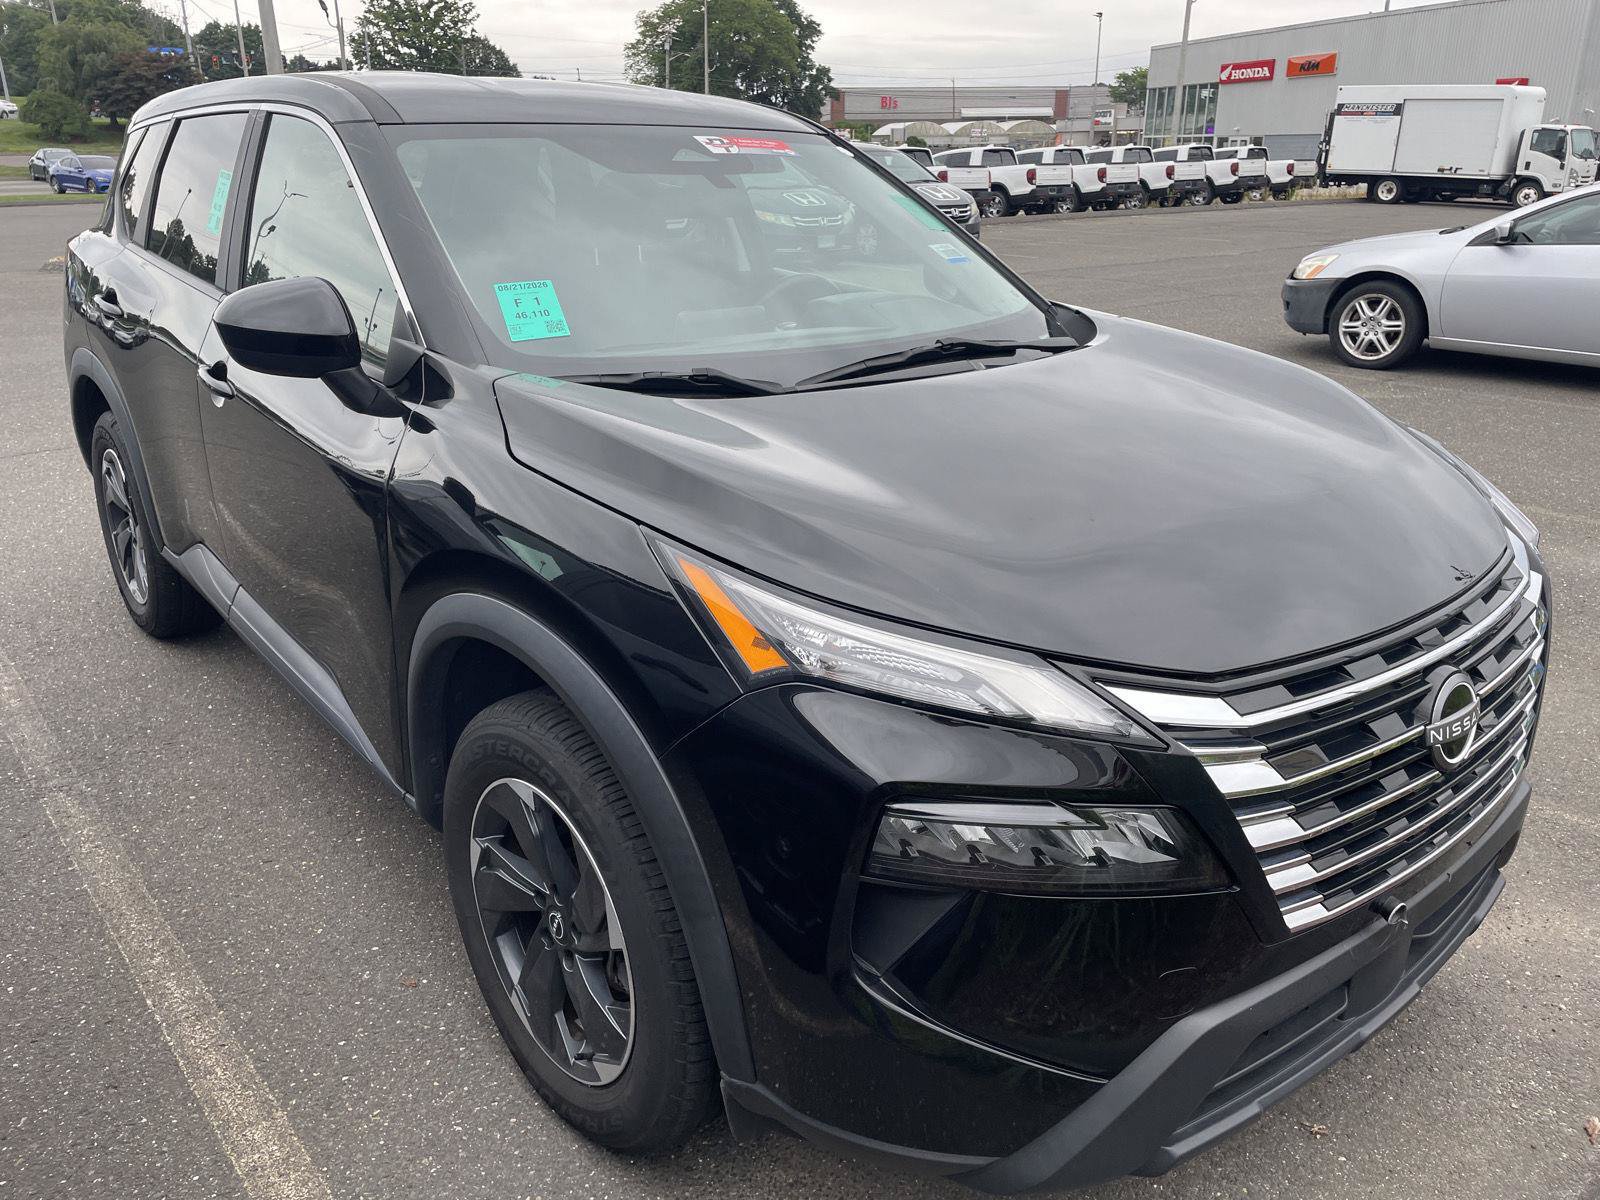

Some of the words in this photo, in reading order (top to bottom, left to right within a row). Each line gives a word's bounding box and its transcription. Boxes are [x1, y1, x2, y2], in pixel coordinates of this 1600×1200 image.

[1299, 59, 1321, 72] KTM
[1231, 66, 1271, 80] HONDA
[1341, 103, 1396, 112] MANCHESTER
[498, 281, 548, 292] 08/21/2026
[514, 298, 523, 308] F
[534, 297, 541, 306] 1
[515, 309, 551, 320] 46,110
